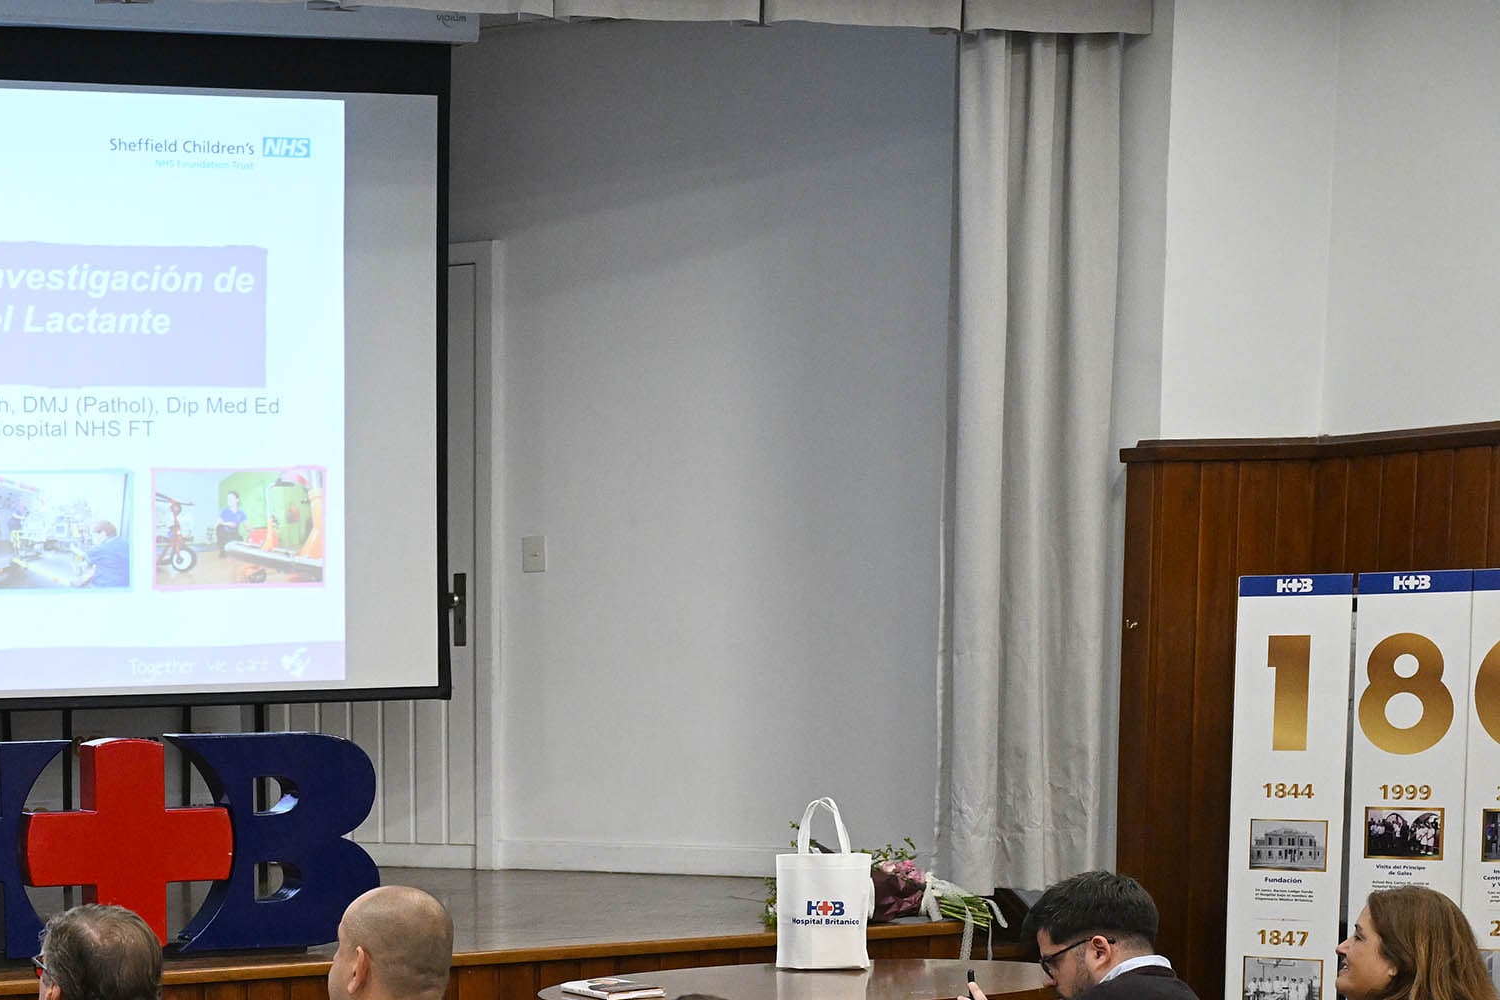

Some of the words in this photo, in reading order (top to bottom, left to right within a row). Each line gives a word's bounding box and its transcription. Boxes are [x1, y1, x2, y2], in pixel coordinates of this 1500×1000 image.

[109, 138, 177, 153] Sheffield
[182, 139, 255, 155] Children's
[263, 138, 309, 157] NHS
[213, 266, 255, 294] de
[23, 305, 172, 336] Lactante
[23, 396, 69, 414] DMJ
[76, 395, 160, 418] (Pathol),
[167, 396, 200, 418] Dip
[207, 397, 247, 415] Med
[255, 397, 281, 415] Ed
[75, 420, 122, 438] NHS
[129, 420, 156, 438] FT
[126, 656, 197, 682] Together
[1262, 782, 1315, 799] 1844
[1379, 784, 1432, 801] 1999
[1264, 876, 1302, 884] Fundación
[792, 918, 823, 926] Hospital
[1257, 929, 1309, 947] 1847
